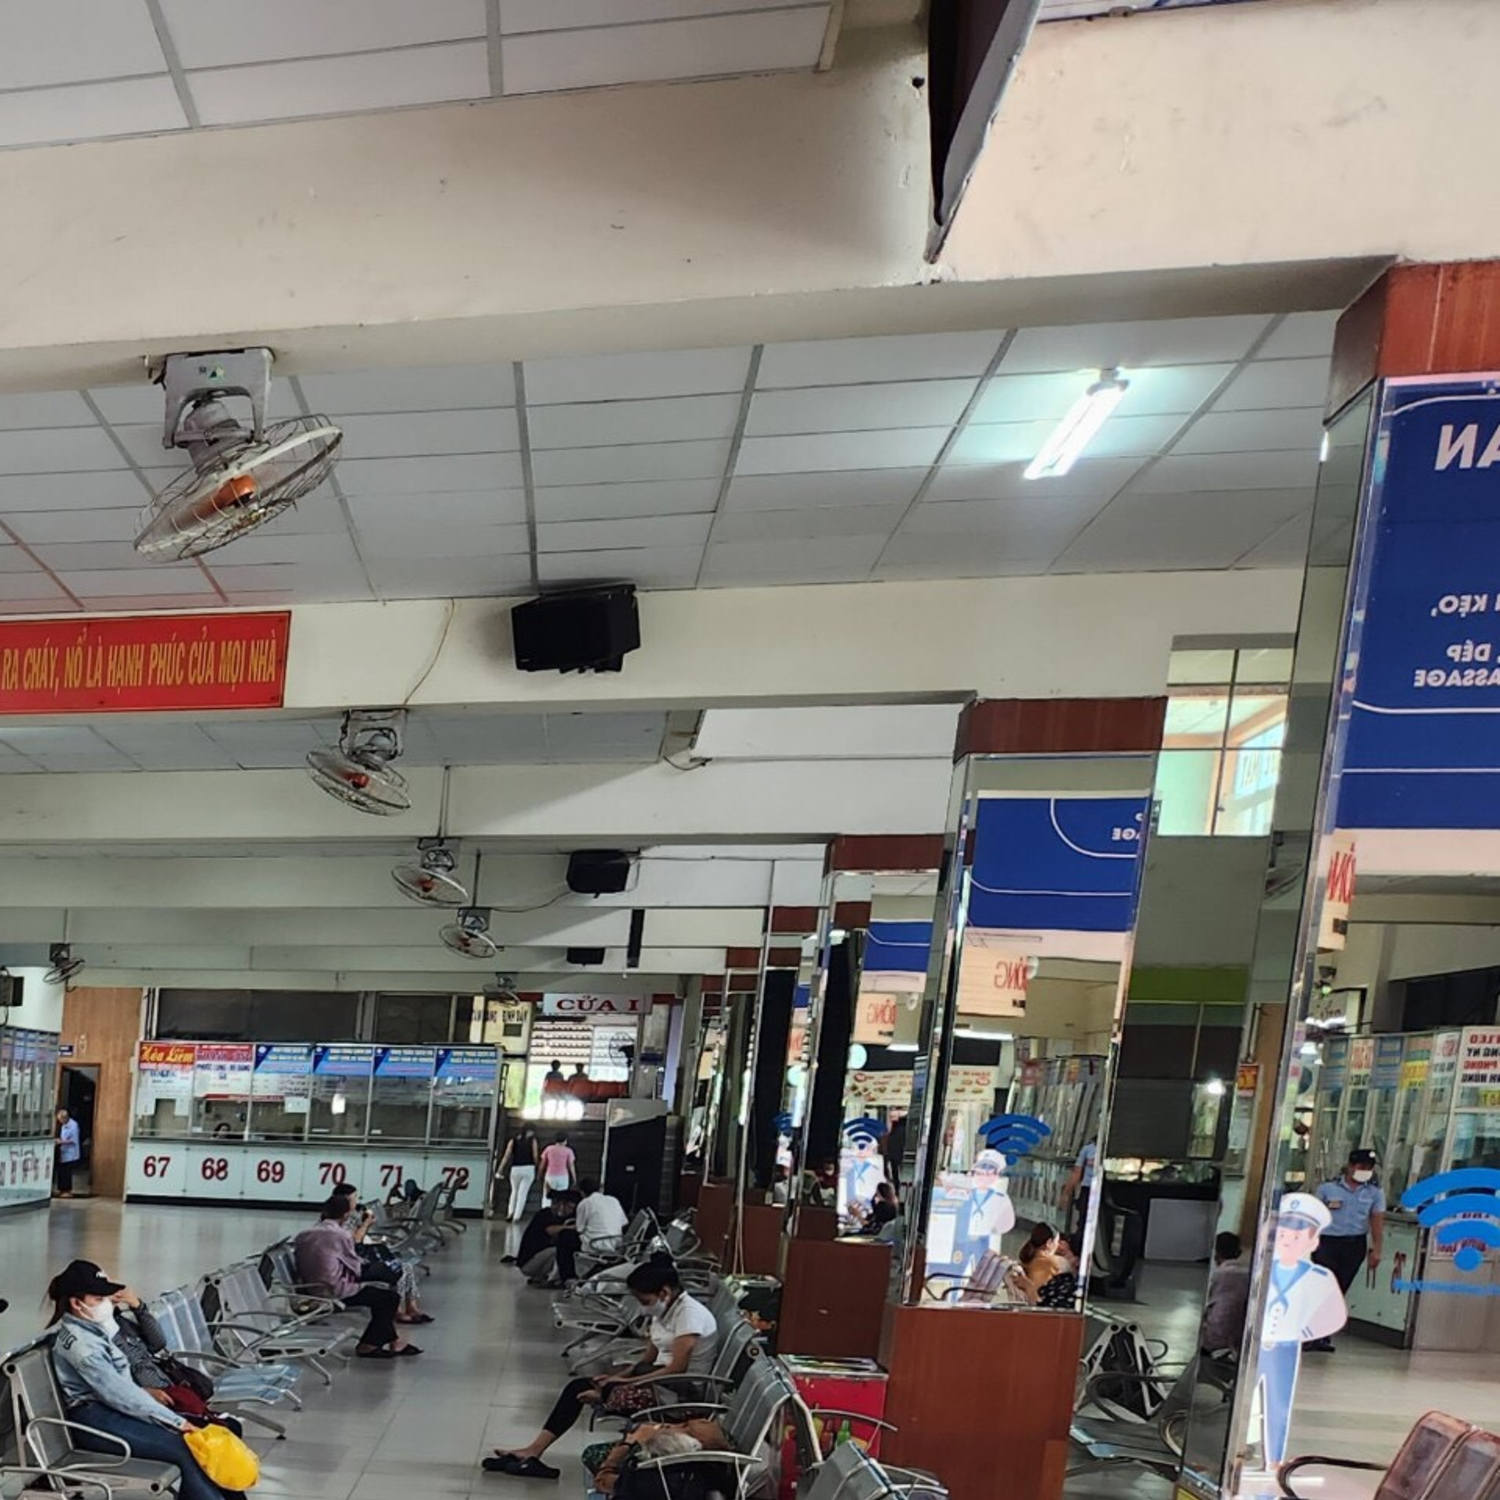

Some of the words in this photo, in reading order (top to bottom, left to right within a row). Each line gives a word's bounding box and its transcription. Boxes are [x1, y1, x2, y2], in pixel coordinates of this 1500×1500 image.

[2, 650, 18, 688] RA
[23, 642, 60, 695] CHÁY,
[64, 628, 87, 688] NỔ
[87, 636, 103, 687] LÀ
[107, 643, 144, 695] HẠNH
[149, 633, 184, 686] PHÚC
[188, 626, 215, 683] CỦA
[218, 640, 247, 692] MỌI
[248, 630, 277, 682] NHÀ
[557, 995, 617, 1011] CỬA
[143, 1156, 170, 1178] 67
[202, 1158, 228, 1180] 68
[257, 1160, 284, 1183] 69
[319, 1163, 346, 1185] 70
[380, 1165, 403, 1187] 71
[442, 1167, 469, 1190] 72
